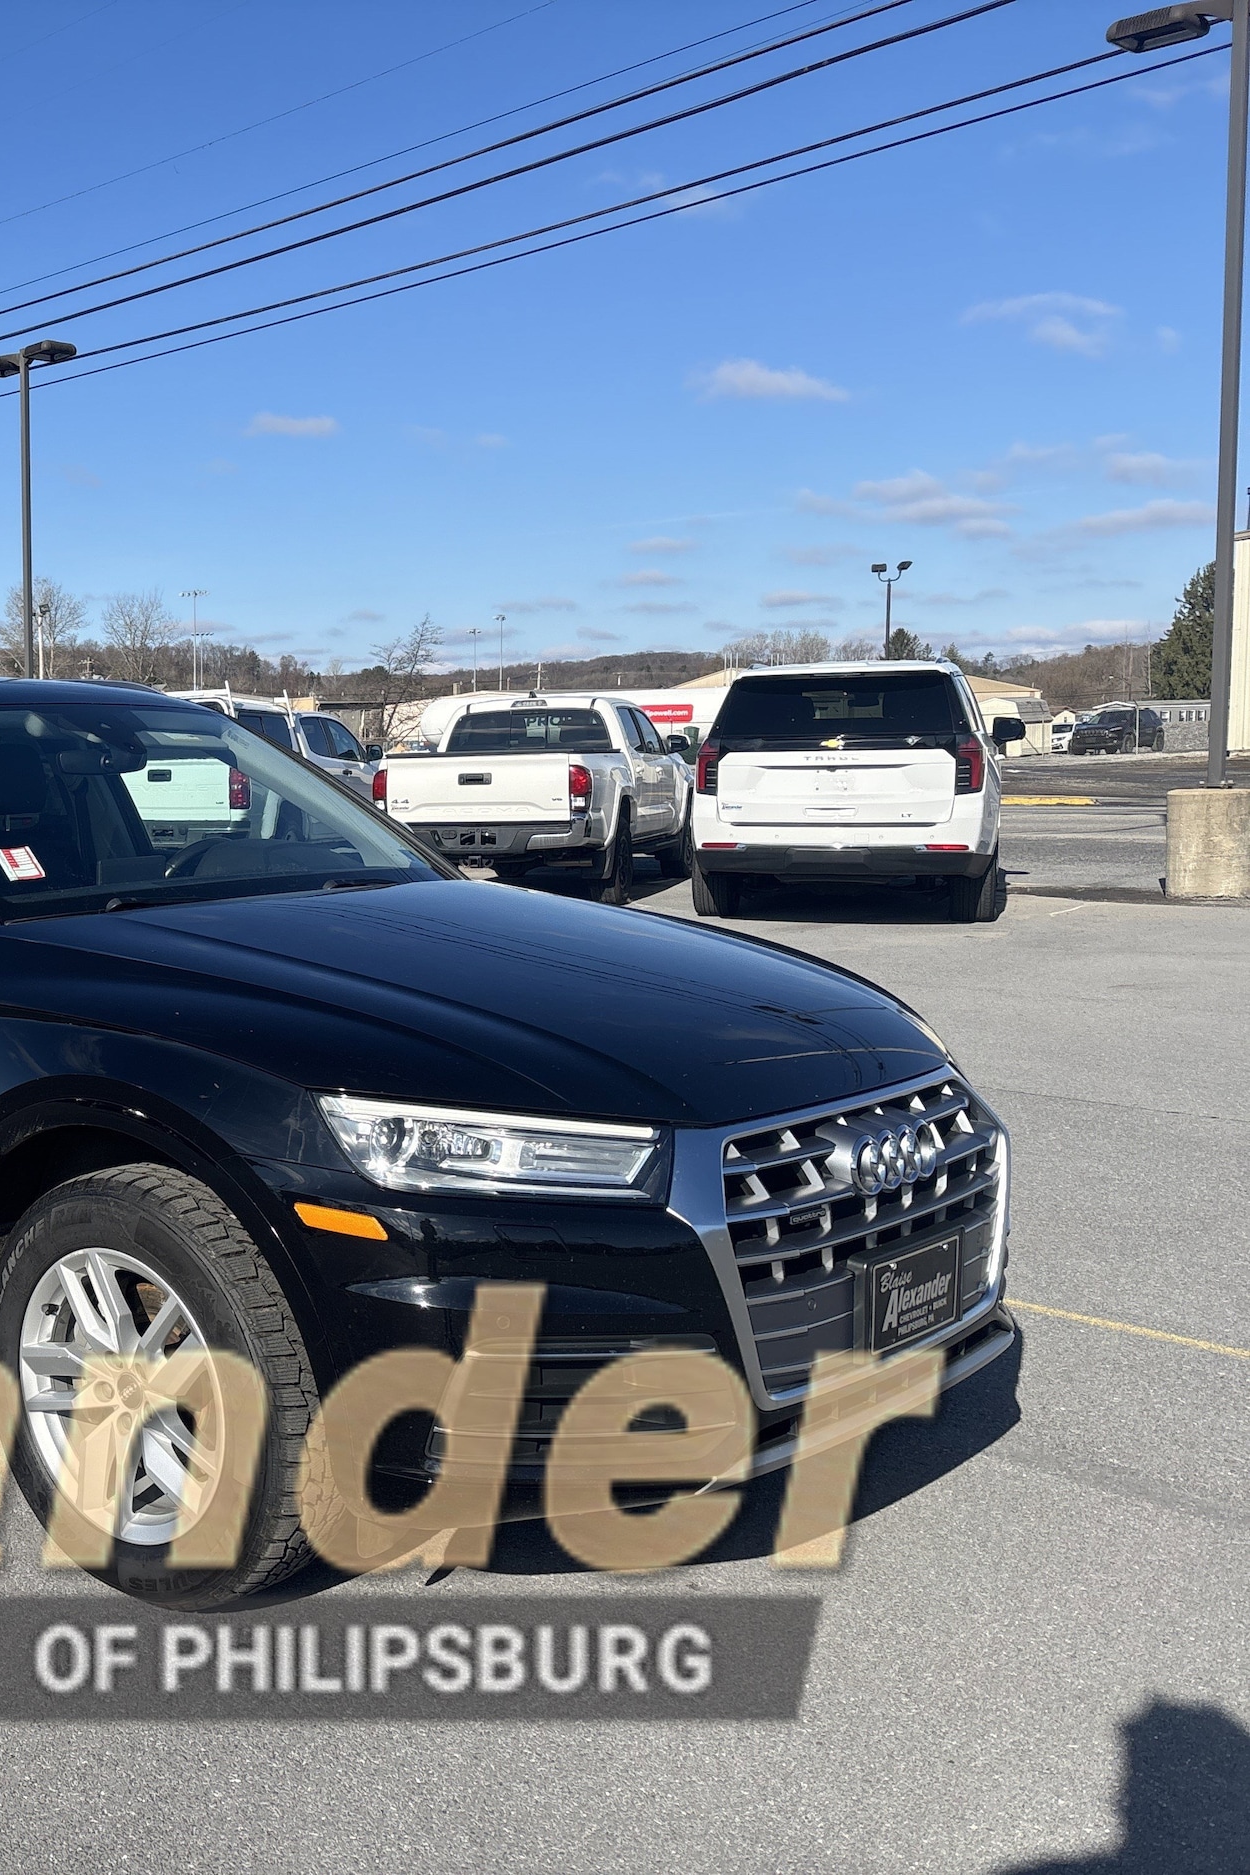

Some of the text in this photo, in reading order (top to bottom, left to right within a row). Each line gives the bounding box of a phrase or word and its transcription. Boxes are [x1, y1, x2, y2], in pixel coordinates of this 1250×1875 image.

[792, 1210, 826, 1223] quattro
[880, 1271, 913, 1293] Blaise
[881, 1272, 952, 1333] Alexander
